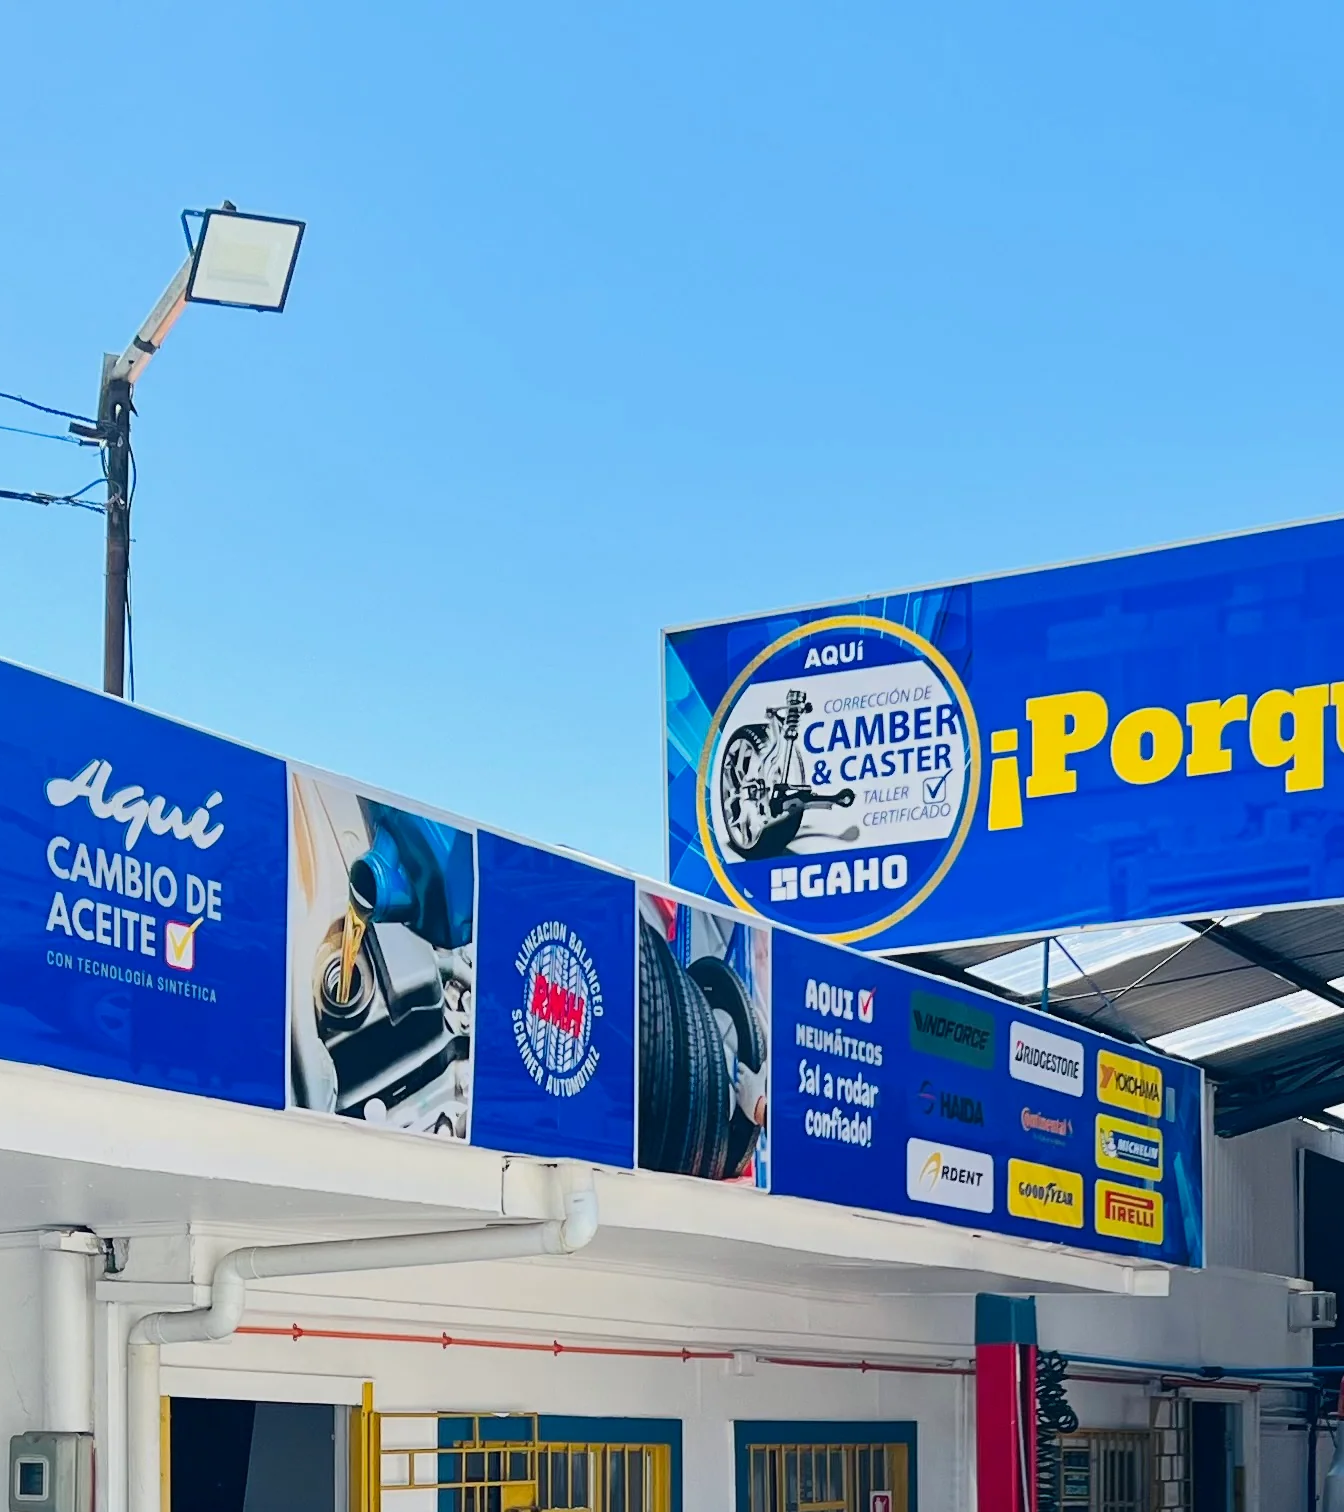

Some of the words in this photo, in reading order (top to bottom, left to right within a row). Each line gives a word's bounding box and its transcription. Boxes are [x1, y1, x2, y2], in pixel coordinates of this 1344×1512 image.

[824, 688, 910, 714] CORRECCIÓN
[913, 685, 933, 700] DE
[804, 703, 957, 754] CAMBER
[811, 760, 832, 786] &
[840, 743, 951, 782] CASTER
[45, 759, 224, 851] Aquí
[863, 803, 952, 827] CERTIFICADO
[864, 786, 909, 804] TALLER
[47, 836, 178, 908] CAMBIO
[186, 874, 222, 921] DE
[46, 891, 156, 957] ACEITE
[47, 950, 73, 969] CON
[77, 957, 153, 988] TECNOLOGÍA
[157, 976, 217, 1003] SINTÉTICA
[514, 921, 567, 976] ALINEACION
[568, 931, 604, 1017] BALANCEO
[805, 978, 854, 1021] AQUI
[511, 1008, 544, 1086] SCANNER
[545, 1045, 600, 1097] AUTOMOTRIZ
[795, 1023, 883, 1067] NEUMÁTICOS
[1015, 1040, 1080, 1079] BRIDGESTONE
[798, 1058, 821, 1097] Sal
[823, 1072, 834, 1100] a
[837, 1071, 879, 1108] rodar
[1114, 1070, 1160, 1103] YOKOHAMA
[805, 1106, 872, 1148] confiado!
[1117, 1138, 1158, 1159] MICHELIN
[1105, 1190, 1154, 1228] PIRELLI
